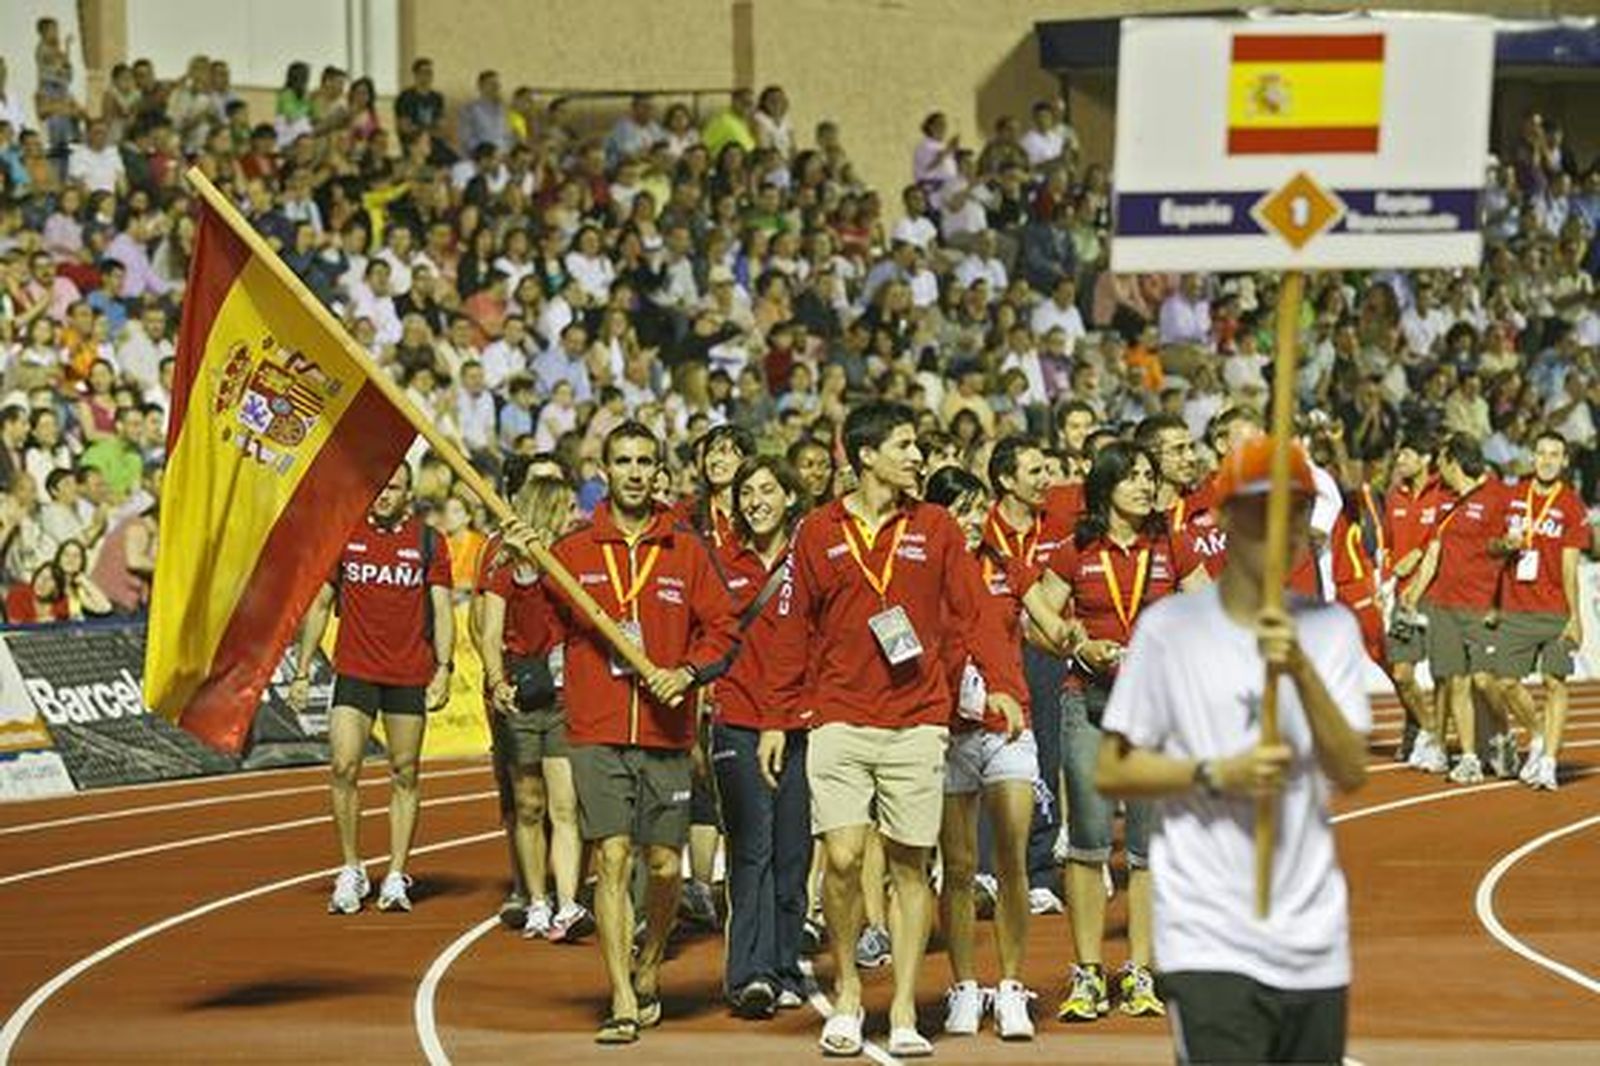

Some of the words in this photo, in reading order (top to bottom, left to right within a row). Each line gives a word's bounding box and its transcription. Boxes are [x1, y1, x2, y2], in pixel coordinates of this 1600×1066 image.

[1291, 197, 1309, 227] 1
[342, 562, 424, 586] SPAÑA
[24, 668, 146, 724] Barcel
